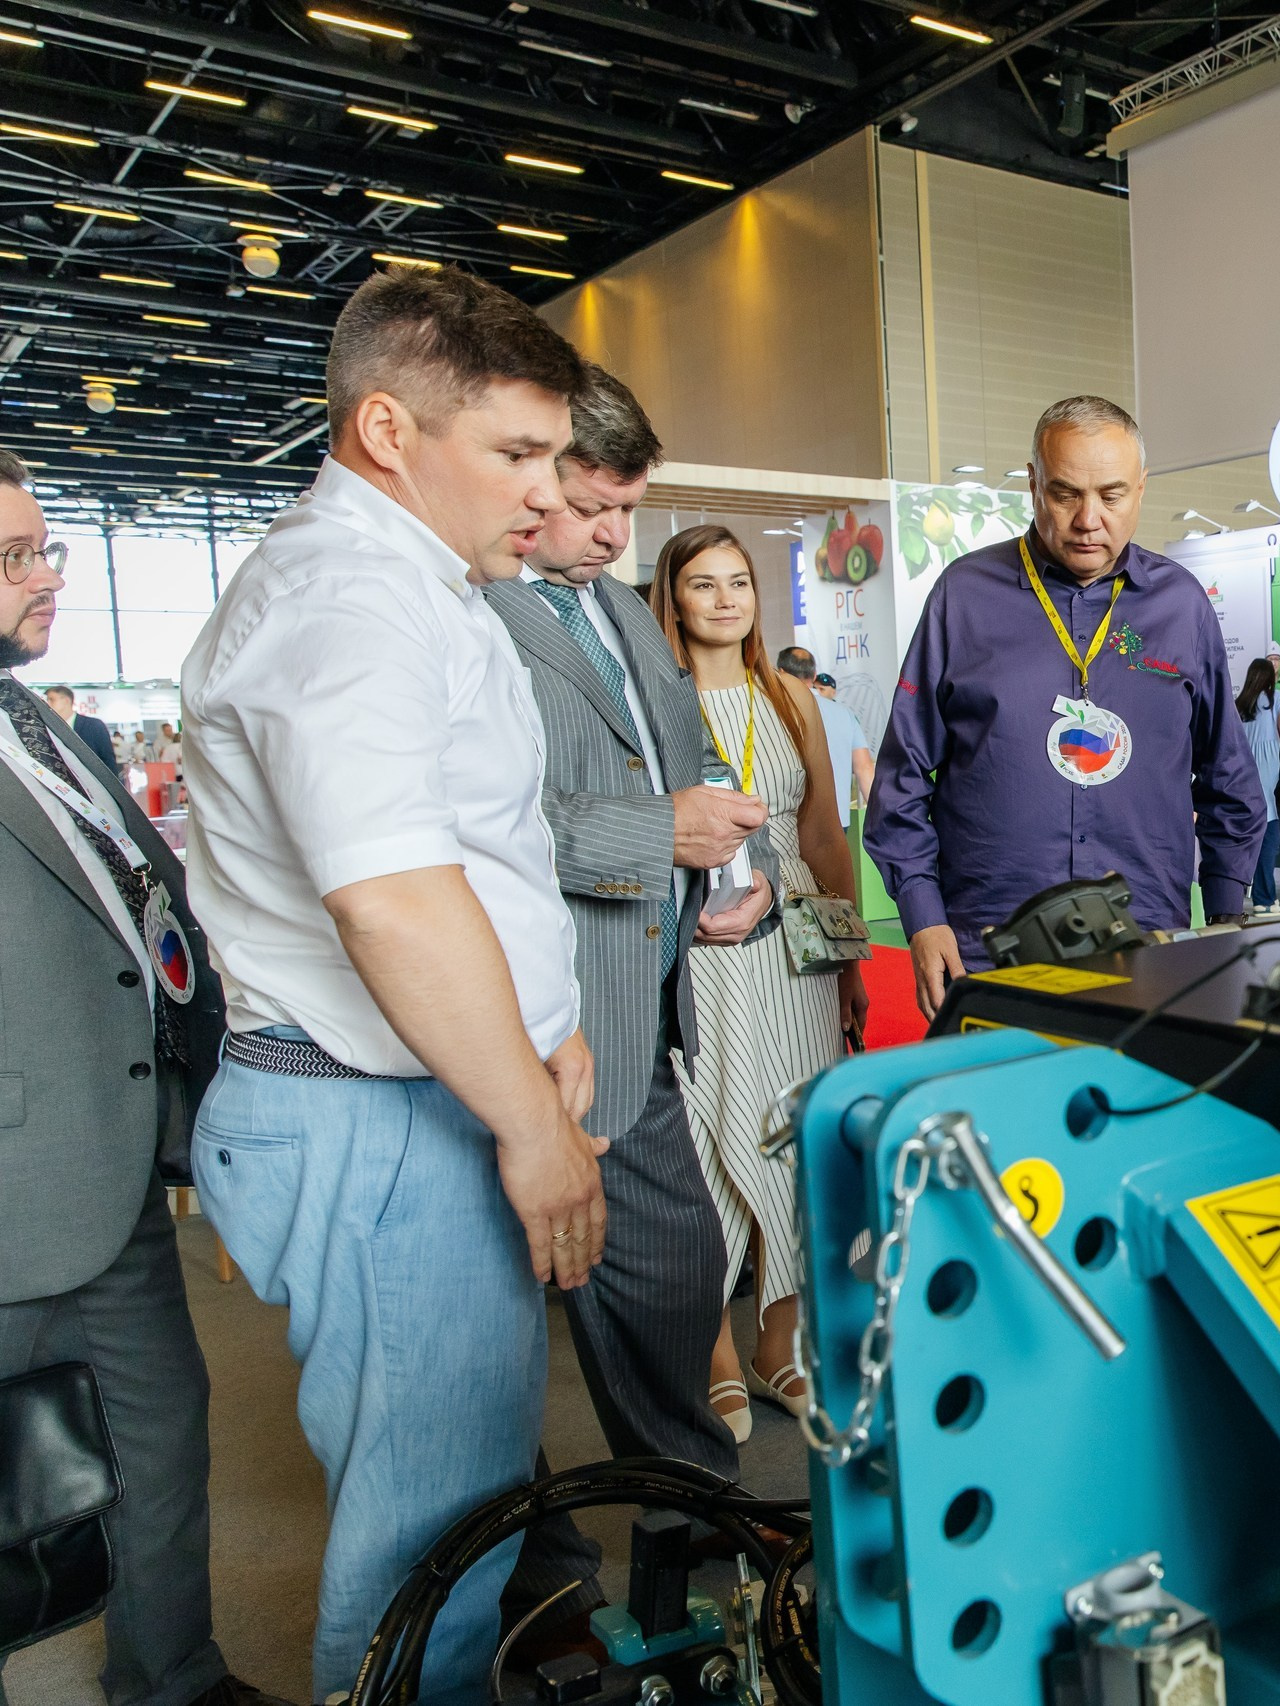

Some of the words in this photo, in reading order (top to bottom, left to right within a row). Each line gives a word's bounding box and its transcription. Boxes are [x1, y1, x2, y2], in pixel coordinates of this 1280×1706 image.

[835, 588, 865, 619] РГС
[836, 633, 870, 665] ДНК
[351, 1651, 374, 1706] INTERPUM
